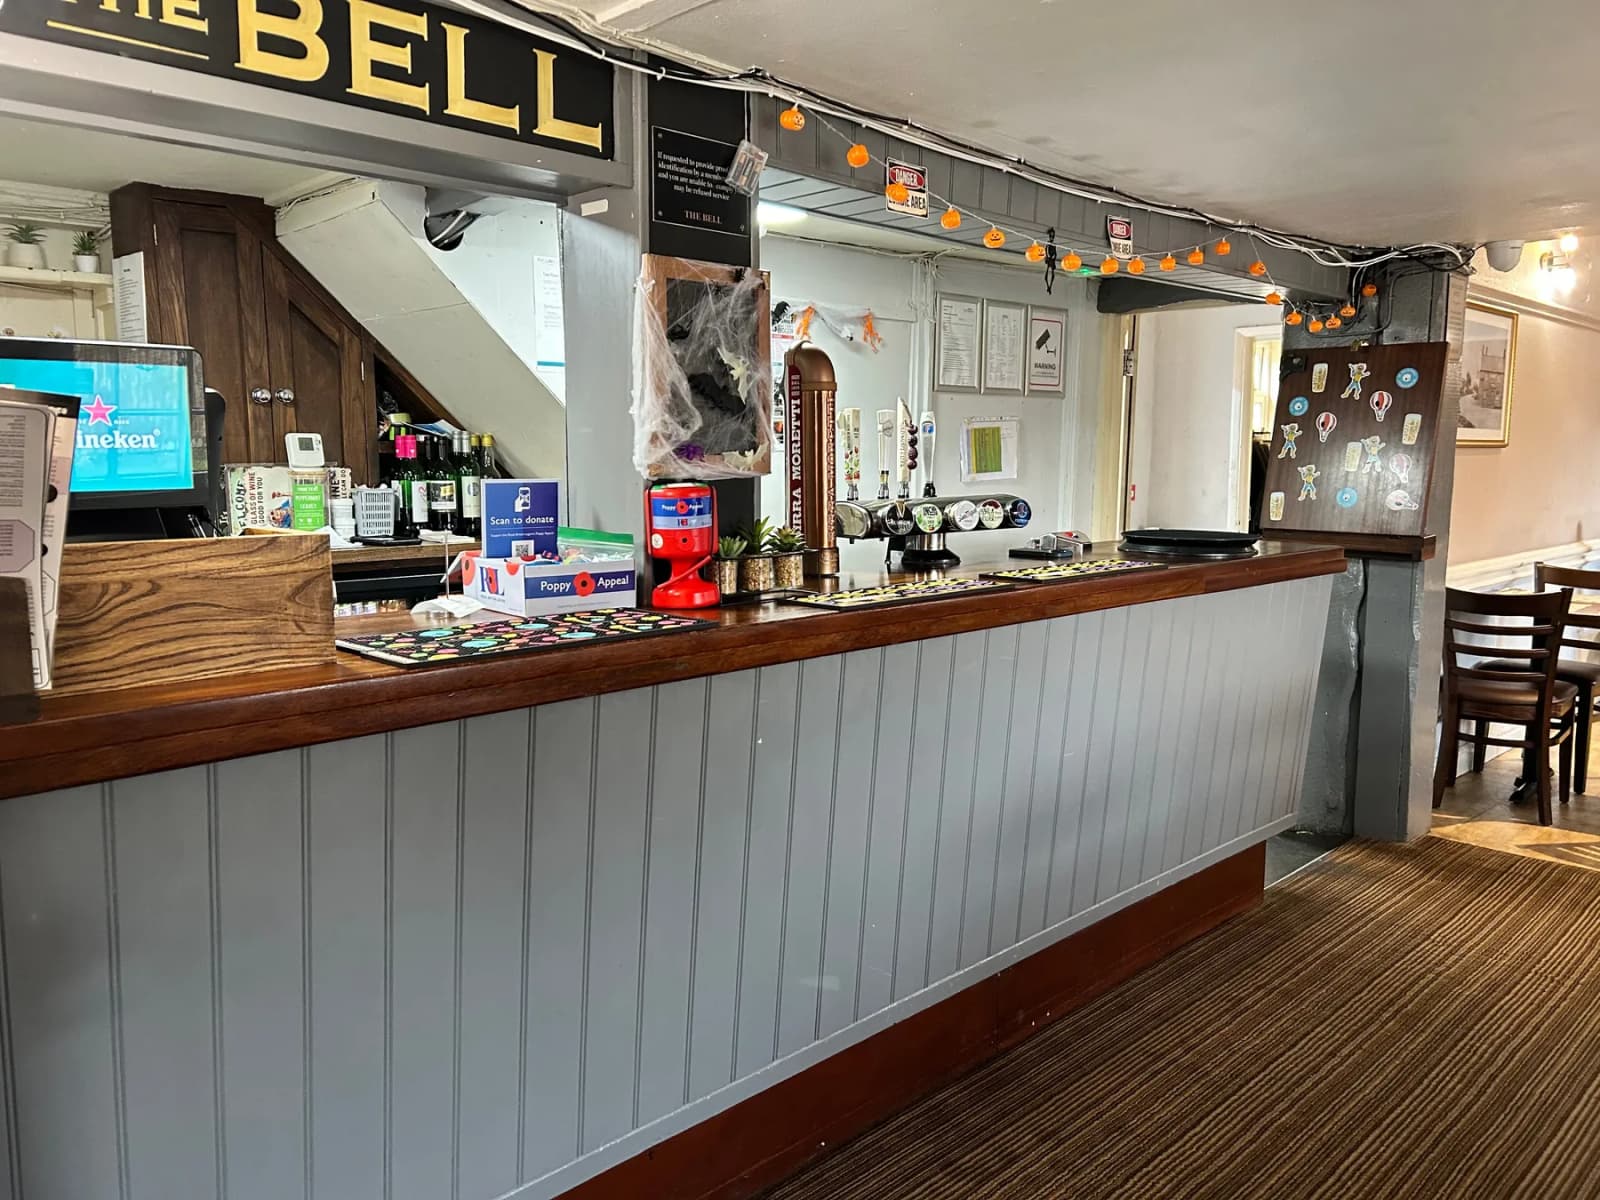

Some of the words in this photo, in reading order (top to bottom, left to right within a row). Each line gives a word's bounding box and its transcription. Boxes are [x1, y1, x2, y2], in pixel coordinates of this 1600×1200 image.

[234, 0, 602, 152] BELL
[896, 169, 918, 186] DANGER
[673, 185, 684, 193] may
[685, 185, 692, 193] be
[692, 188, 712, 198] refused
[685, 210, 702, 221] THE
[702, 213, 721, 224] BELL
[1034, 362, 1056, 370] WARNING
[76, 429, 157, 449] ineken
[791, 399, 801, 481] MORETTI
[248, 472, 256, 491] WINE
[249, 493, 256, 501] OF
[249, 502, 257, 525] GLASS
[490, 516, 510, 526] Scan
[525, 515, 554, 524] donate
[540, 580, 572, 593] Poppy
[596, 575, 629, 589] Appeal
